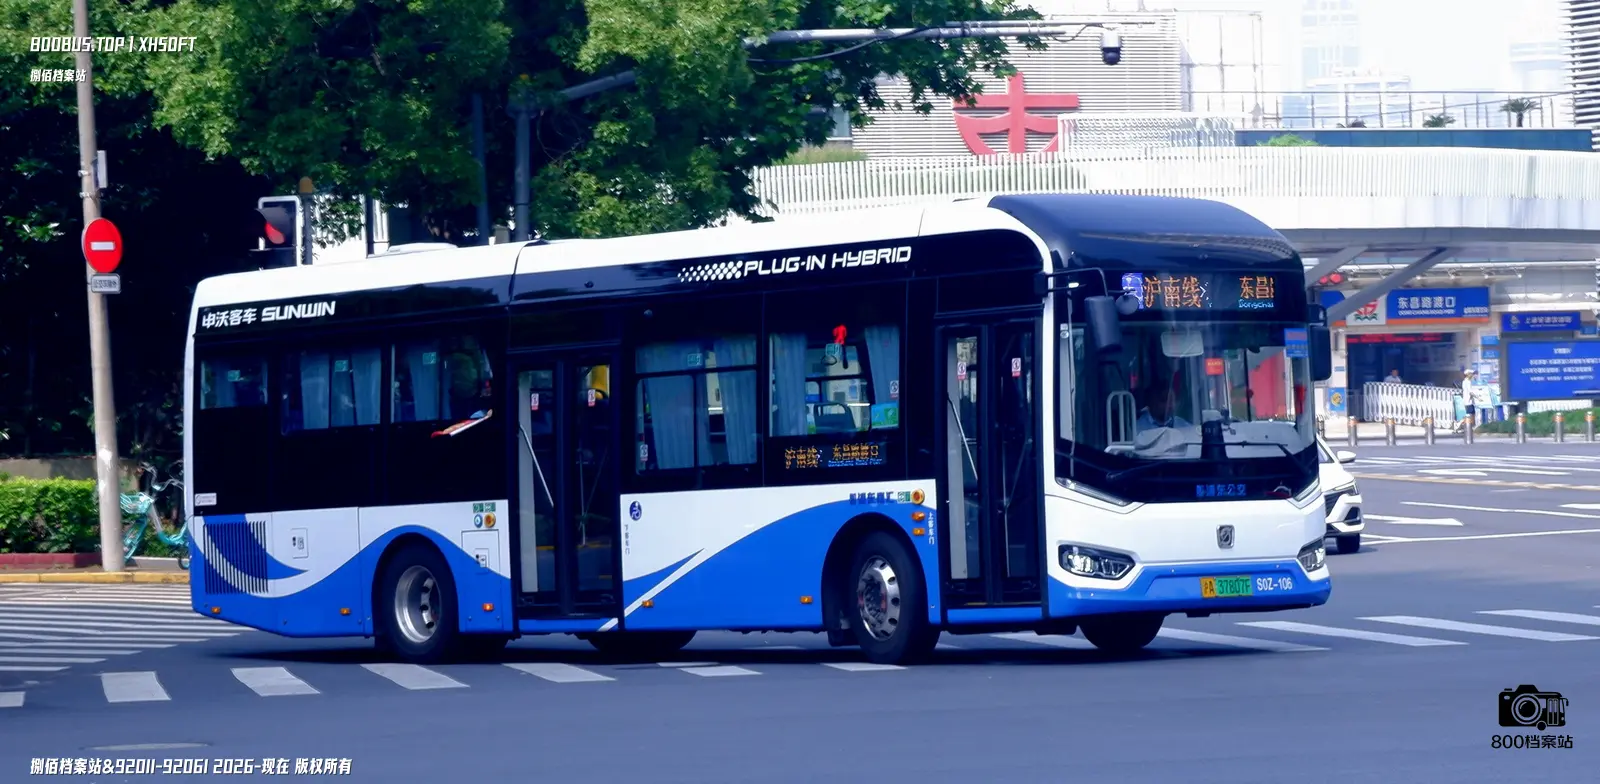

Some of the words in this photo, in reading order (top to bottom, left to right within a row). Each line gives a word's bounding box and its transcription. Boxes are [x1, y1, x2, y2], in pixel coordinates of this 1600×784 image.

[743, 253, 827, 277] PLUG-IN
[831, 246, 912, 269] HYBRID
[1144, 275, 1202, 308] 沪南线
[1398, 295, 1457, 310] 东昌路渡口
[201, 307, 258, 329] 申沃客车
[261, 300, 337, 322] SUNWIN
